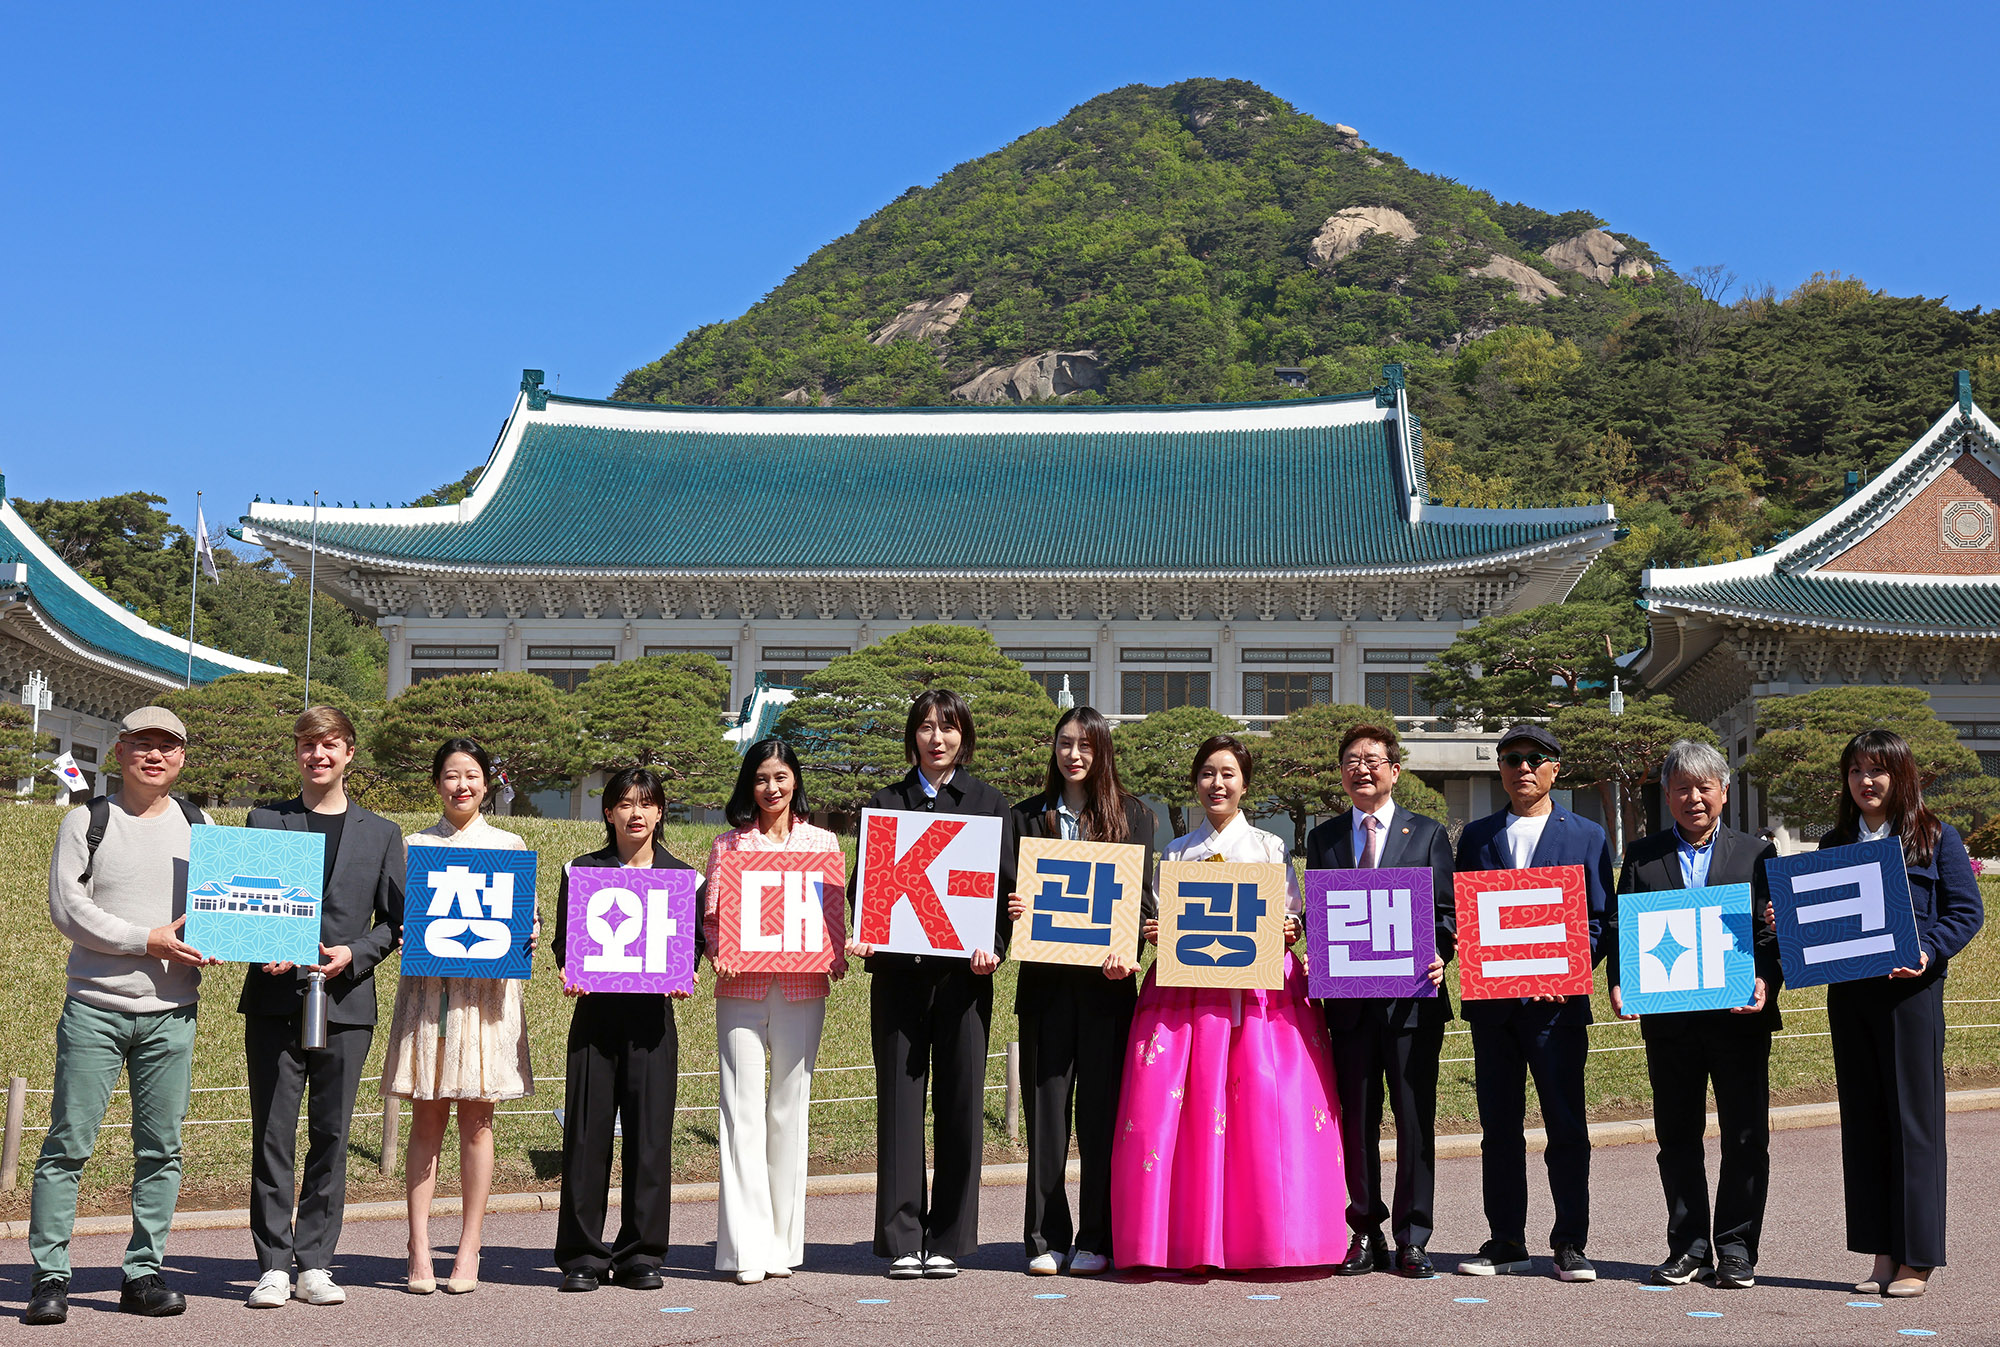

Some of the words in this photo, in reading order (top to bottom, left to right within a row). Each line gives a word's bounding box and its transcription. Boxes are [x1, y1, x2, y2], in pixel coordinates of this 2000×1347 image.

[425, 866, 514, 959] 청
[584, 888, 676, 973] 와
[740, 871, 823, 952] 대
[1032, 859, 1122, 945] 관
[1177, 882, 1265, 966] 광
[1327, 889, 1414, 976] 랜
[1477, 888, 1569, 977] 드
[1791, 862, 1895, 964] 크
[1638, 906, 1733, 993] 마
